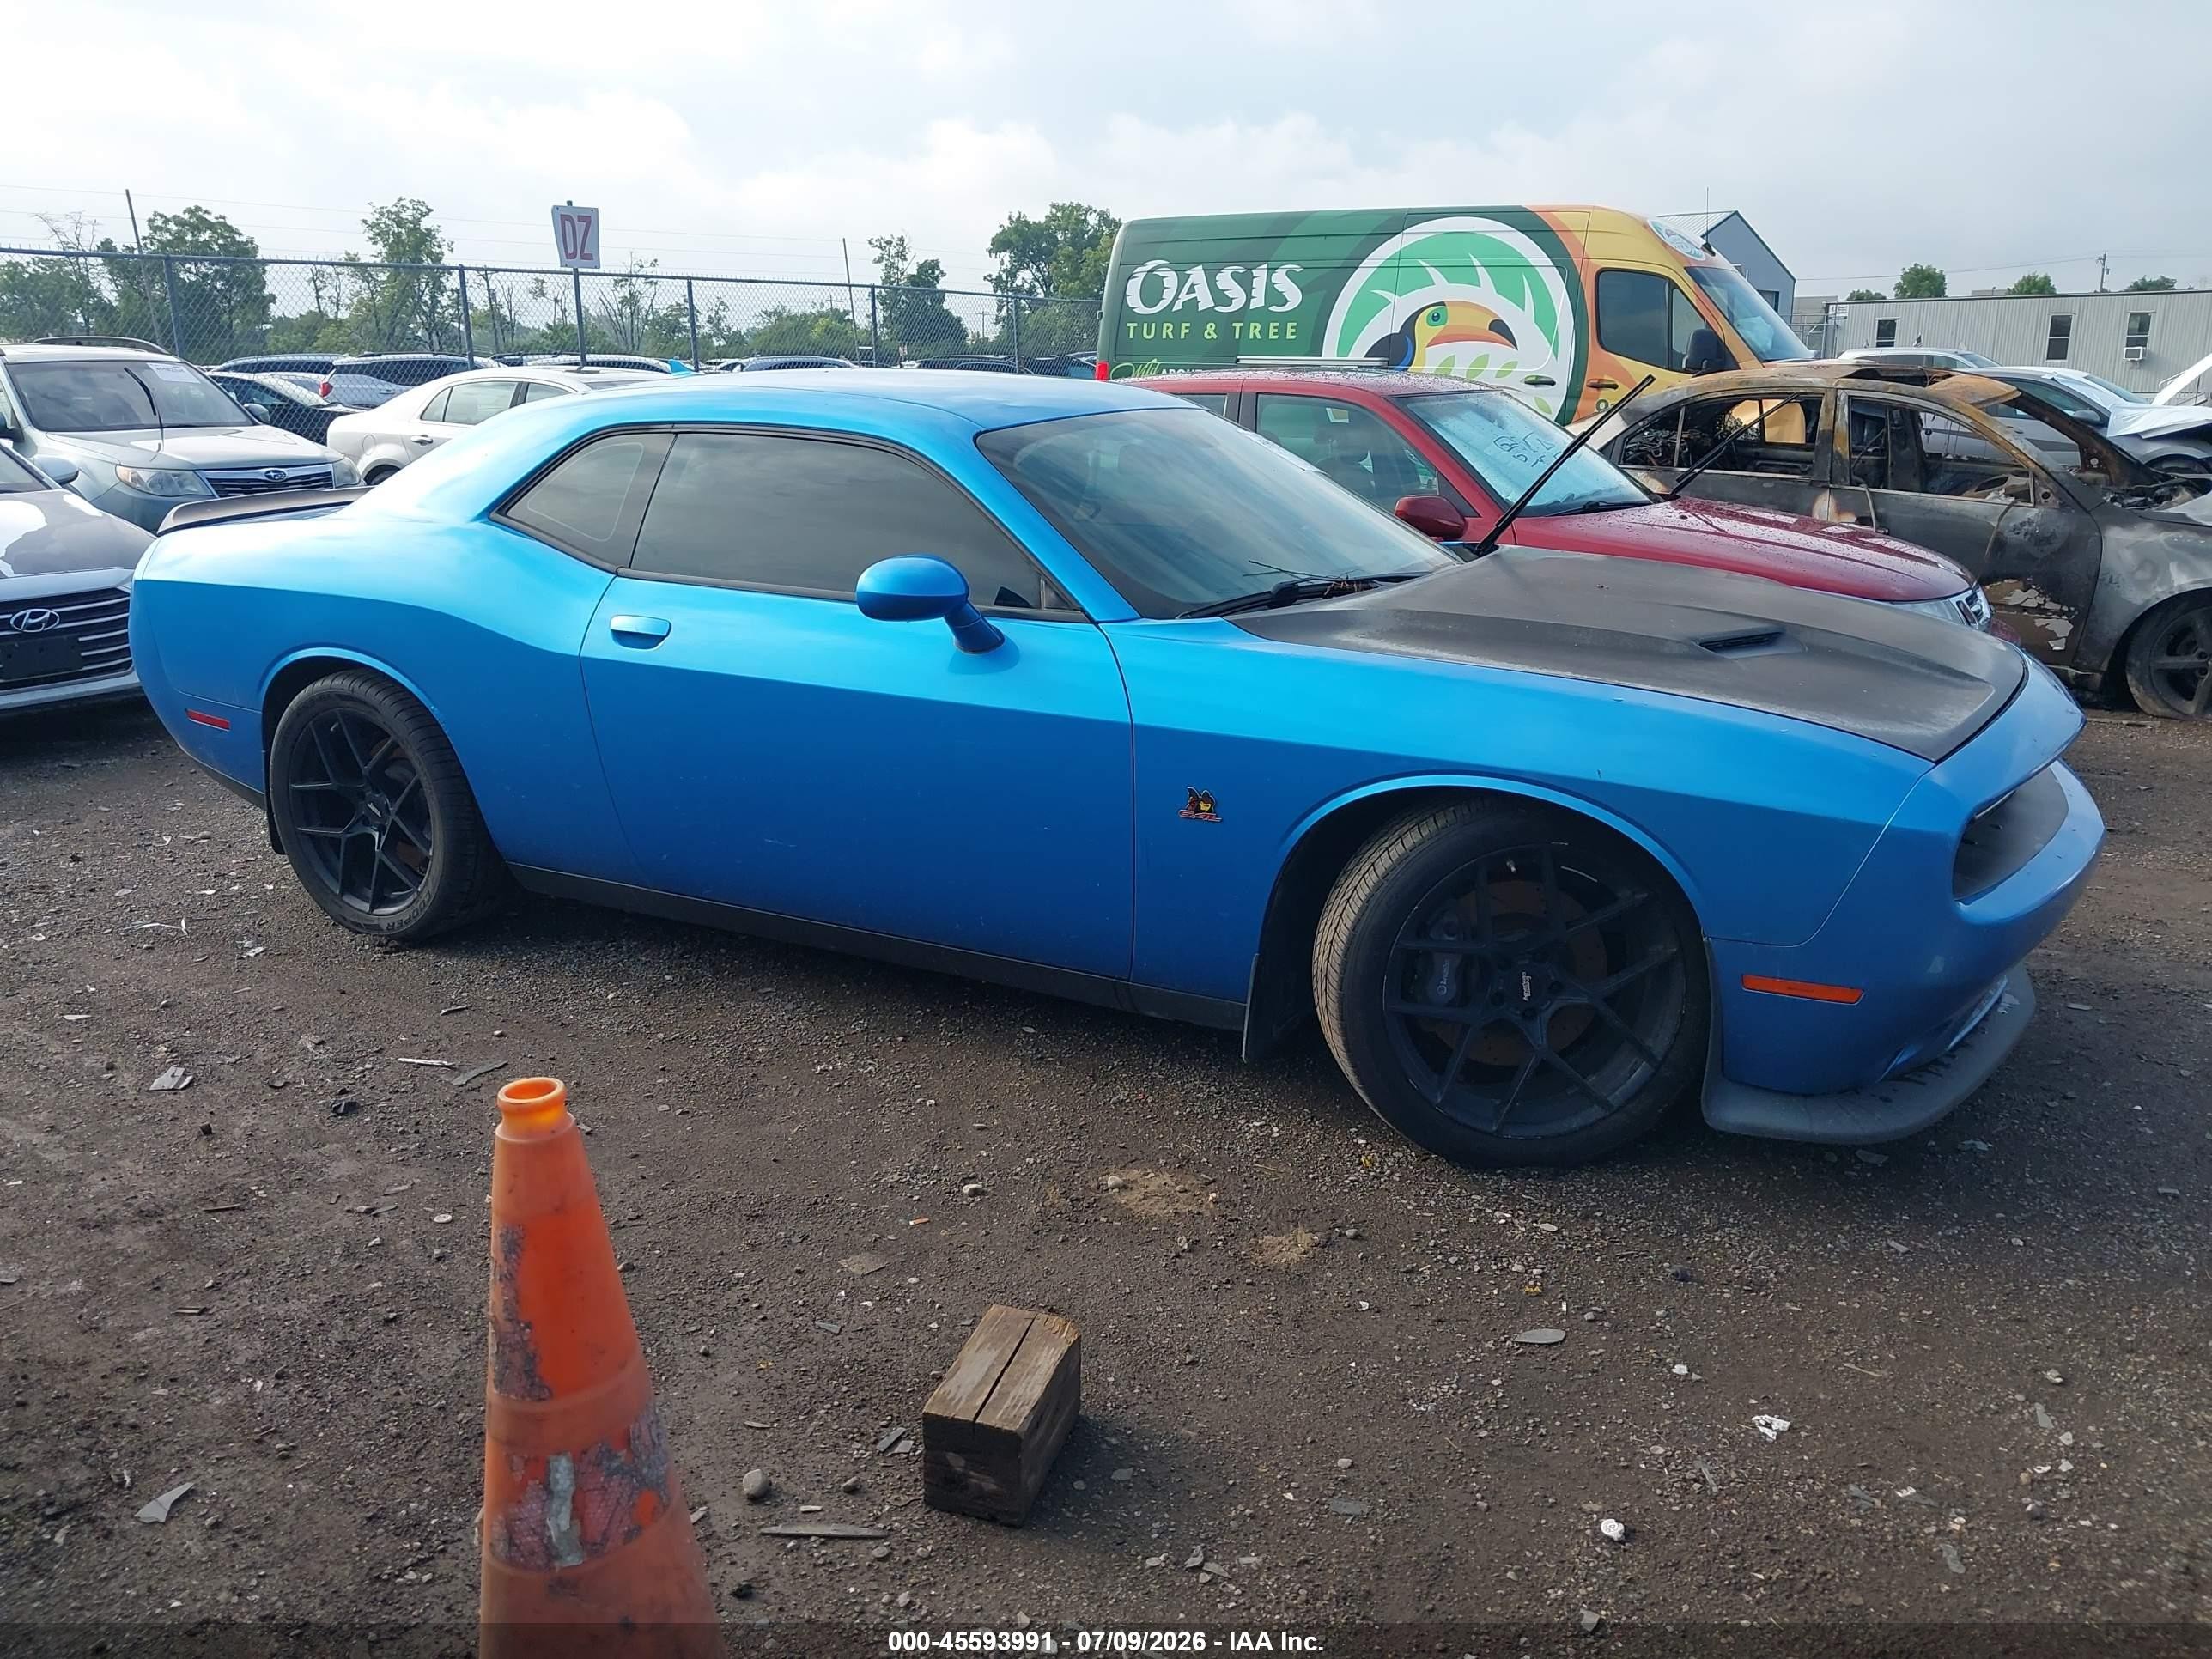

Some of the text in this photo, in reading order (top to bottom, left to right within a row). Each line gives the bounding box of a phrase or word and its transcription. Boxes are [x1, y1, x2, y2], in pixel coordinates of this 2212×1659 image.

[560, 214, 593, 260] DZ
[1126, 259, 1304, 314] OASIS
[1127, 322, 1297, 339] TURF & TREE
